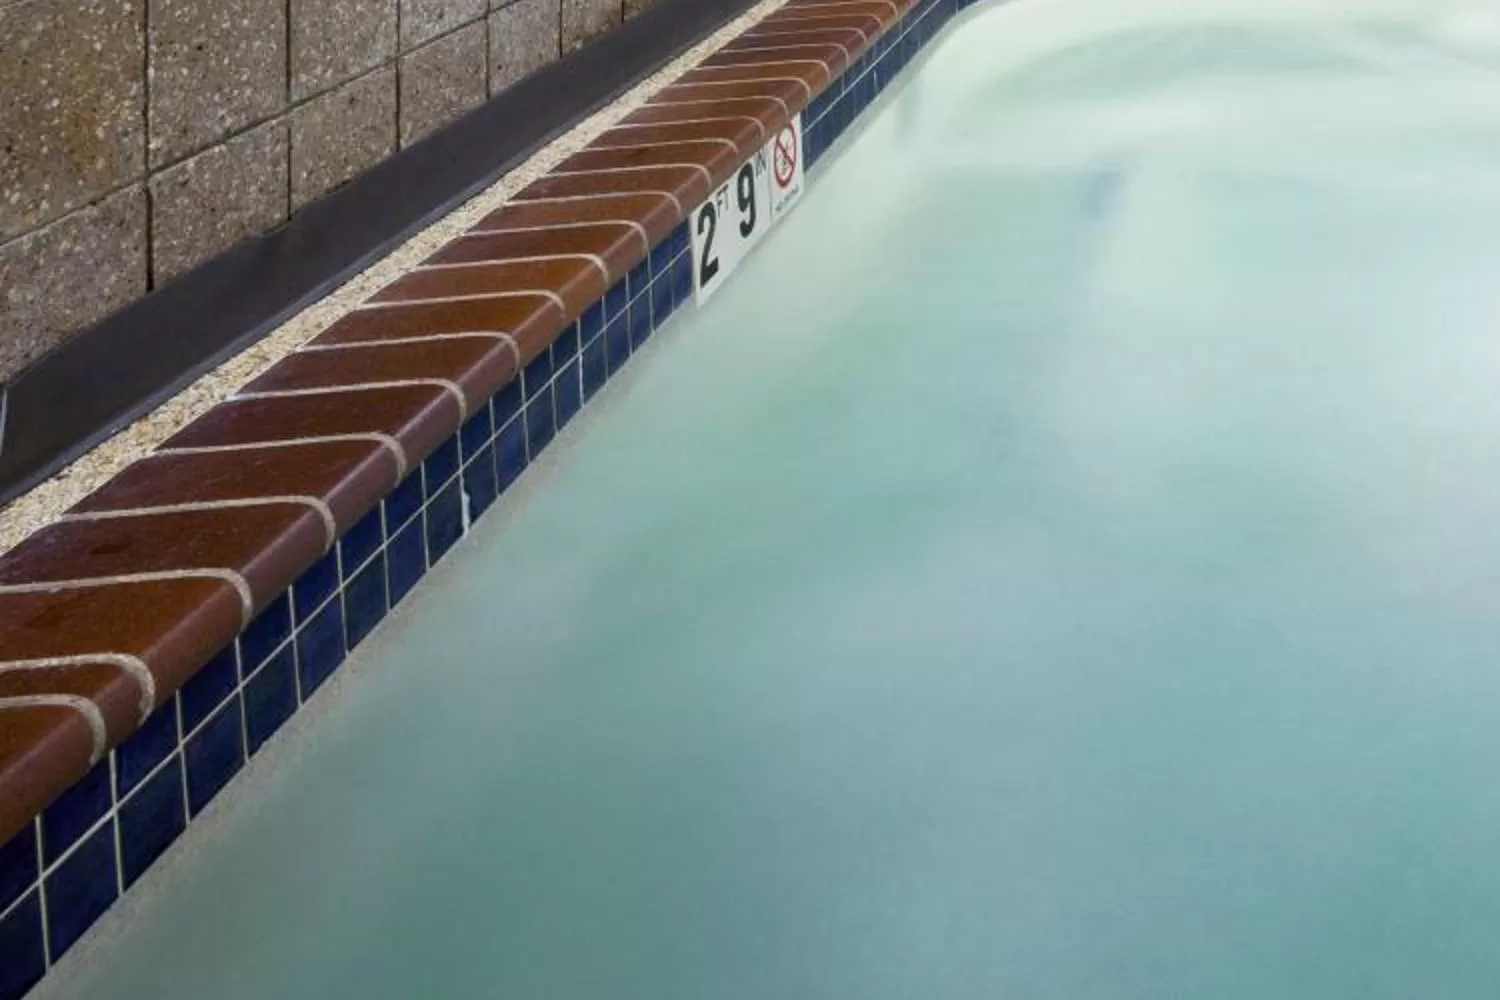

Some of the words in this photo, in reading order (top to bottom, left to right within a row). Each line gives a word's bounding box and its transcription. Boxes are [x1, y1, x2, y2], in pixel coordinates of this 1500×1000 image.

[698, 202, 719, 288] 2
[716, 184, 729, 217] FT
[737, 163, 756, 238] 9
